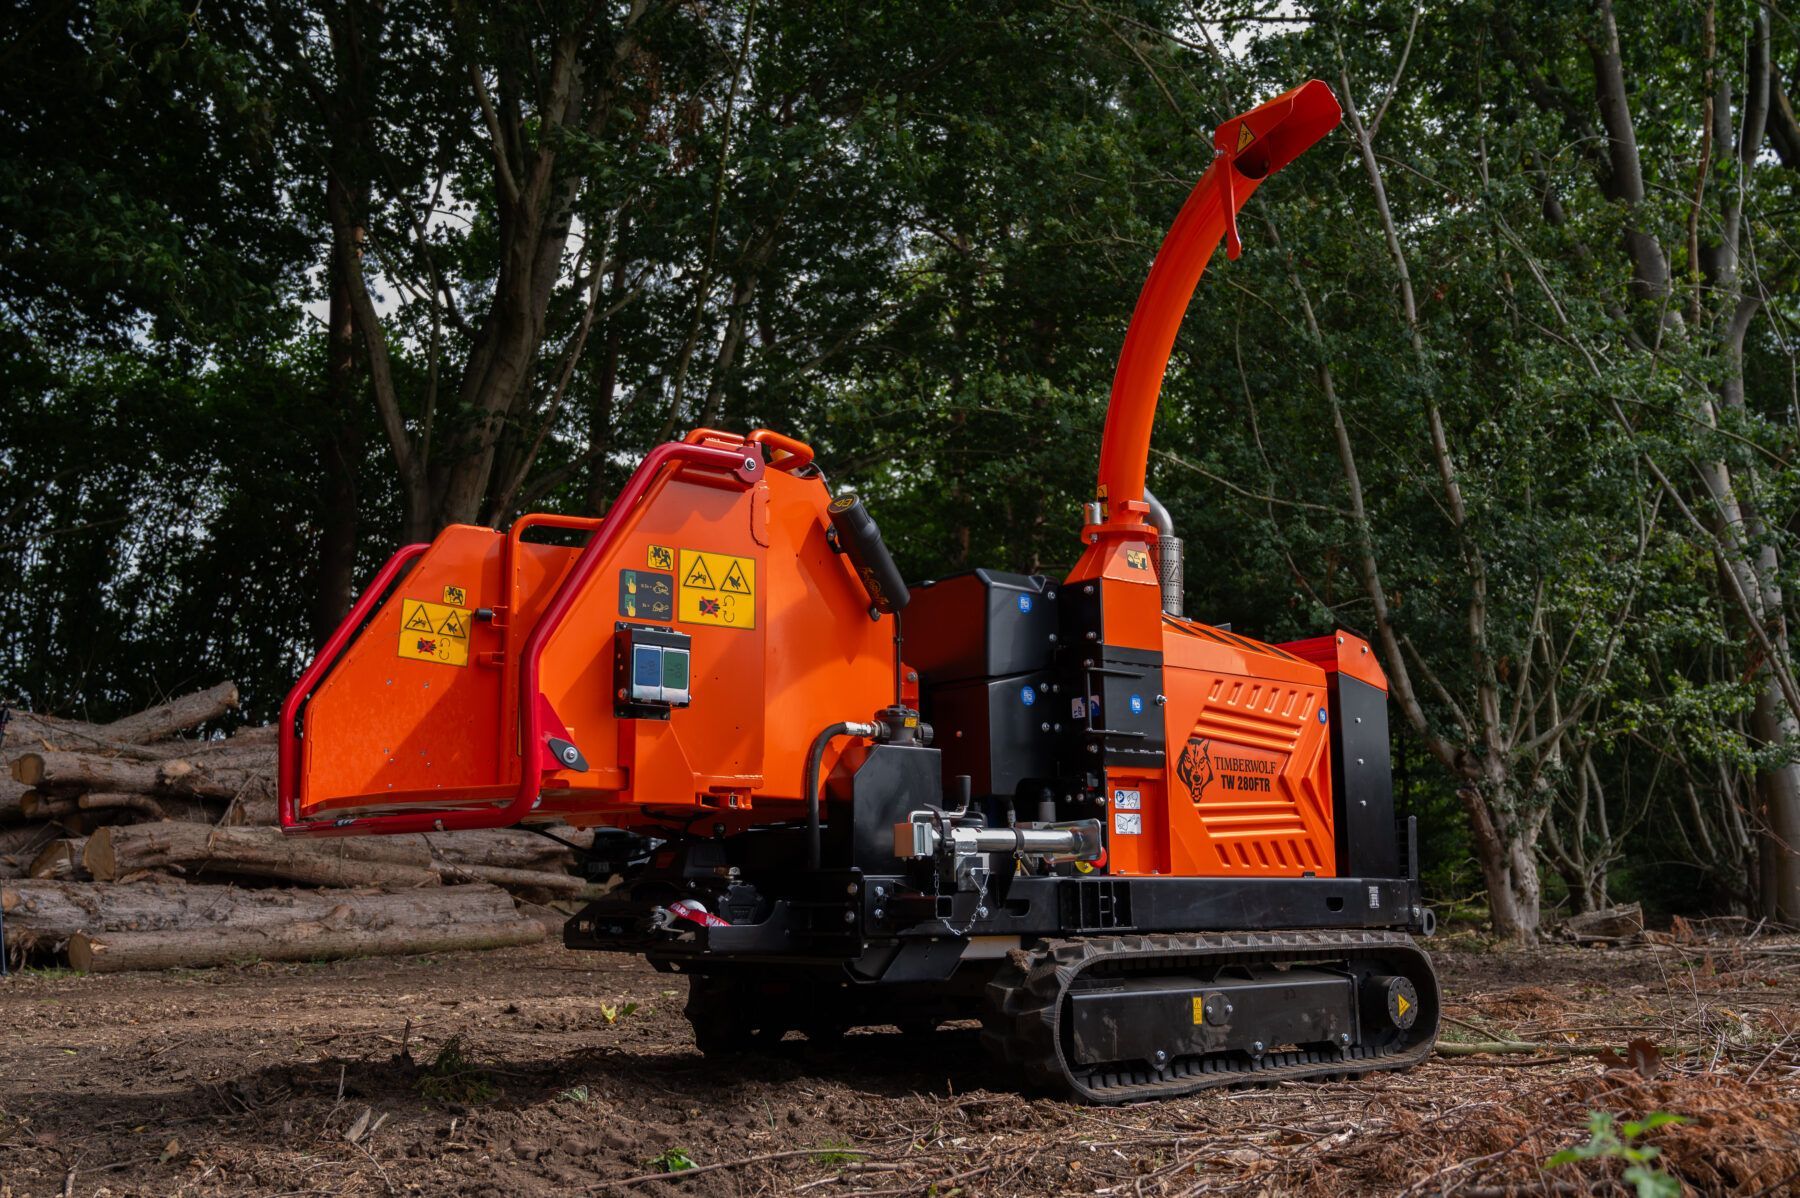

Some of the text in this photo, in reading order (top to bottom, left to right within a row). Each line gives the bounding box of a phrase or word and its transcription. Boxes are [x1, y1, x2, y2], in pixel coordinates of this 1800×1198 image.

[1214, 756, 1276, 775] TIMBERWOLF
[1221, 774, 1271, 792] TW 280FTR
